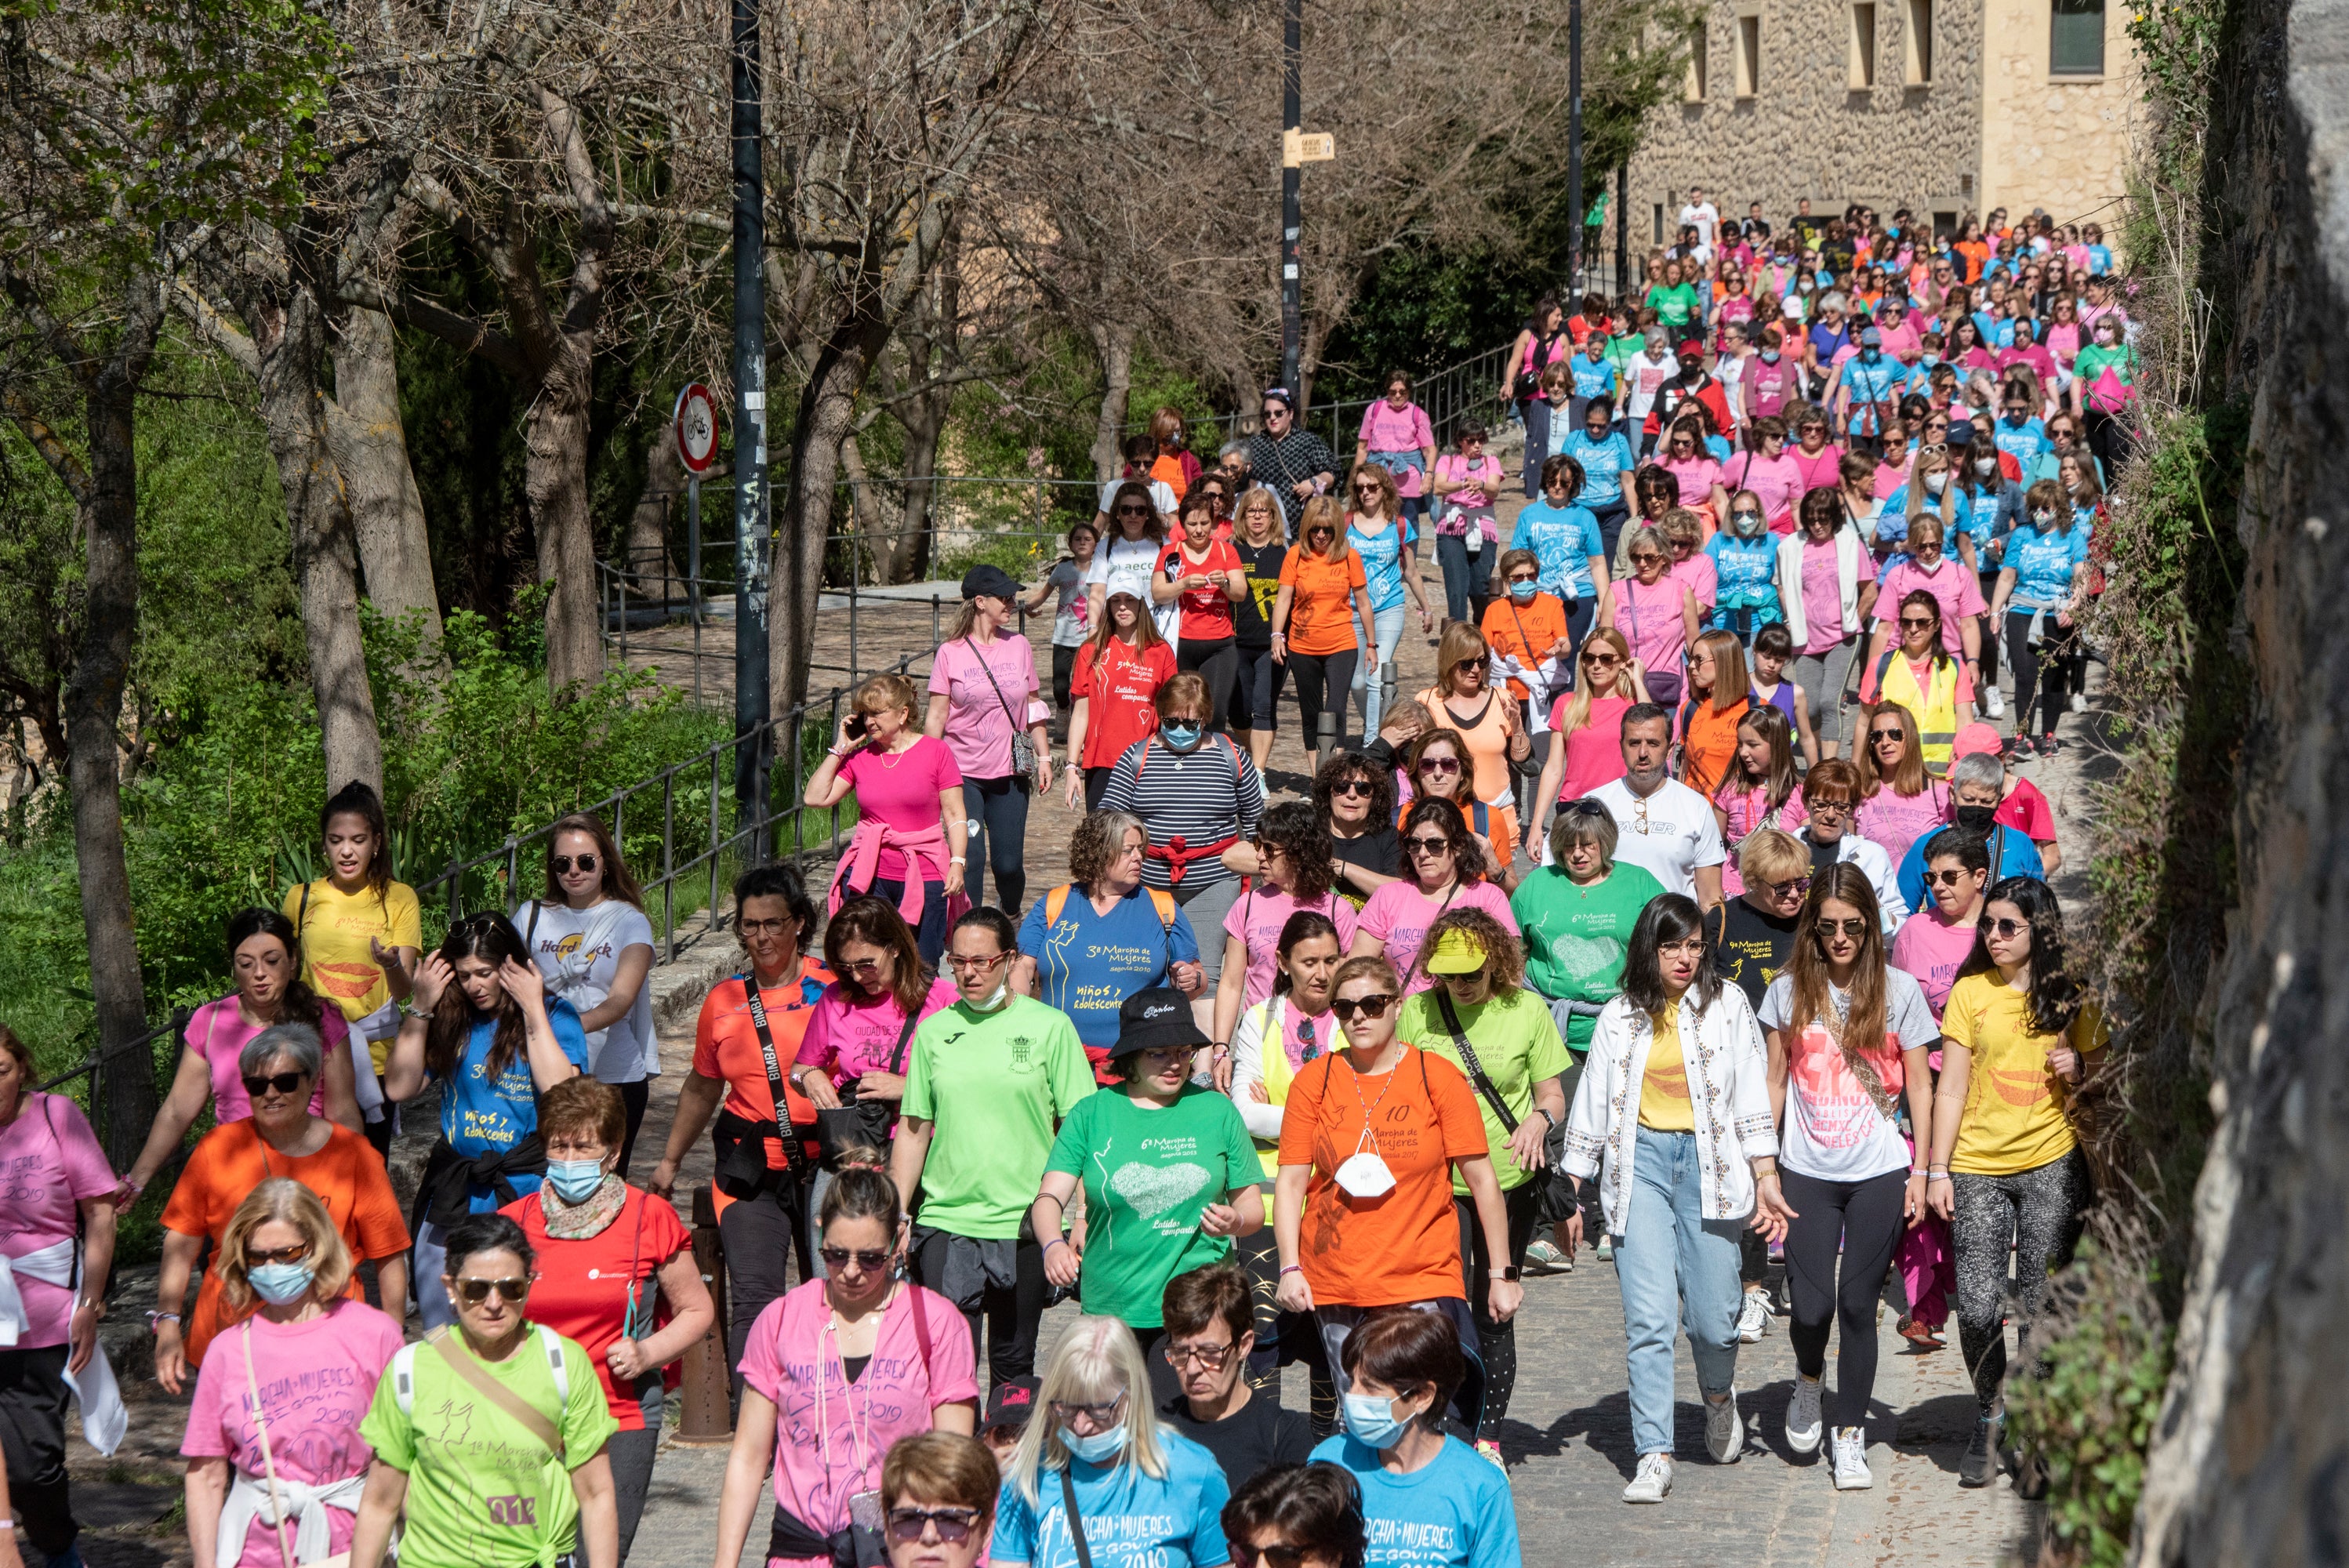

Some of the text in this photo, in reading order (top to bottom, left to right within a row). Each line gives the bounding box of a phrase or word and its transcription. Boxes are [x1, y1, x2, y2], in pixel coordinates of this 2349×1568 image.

[1616, 821, 1676, 836] TARTER
[540, 940, 578, 953] Hard
[1102, 945, 1140, 956] Marcha
[1109, 954, 1151, 965] Mujeres
[1076, 984, 1122, 999] niños y
[1073, 995, 1123, 1010] adolescente
[750, 993, 768, 1029] BIMBA
[762, 1043, 781, 1081] BIMBA
[503, 1072, 528, 1083] archa
[774, 1098, 793, 1138] BIMBA
[1385, 1105, 1410, 1123] 10
[499, 1116, 508, 1129] y
[1154, 1138, 1186, 1148] Marcha
[1160, 1143, 1197, 1152] Mujeres
[1402, 1151, 1419, 1161] 2017
[2, 1185, 45, 1203] 2019
[1153, 1218, 1181, 1229] Latidos
[314, 1406, 354, 1427] 2019
[859, 1399, 902, 1425] 2019
[1120, 1514, 1174, 1541] MUJERES
[1401, 1522, 1454, 1551] MUJERES
